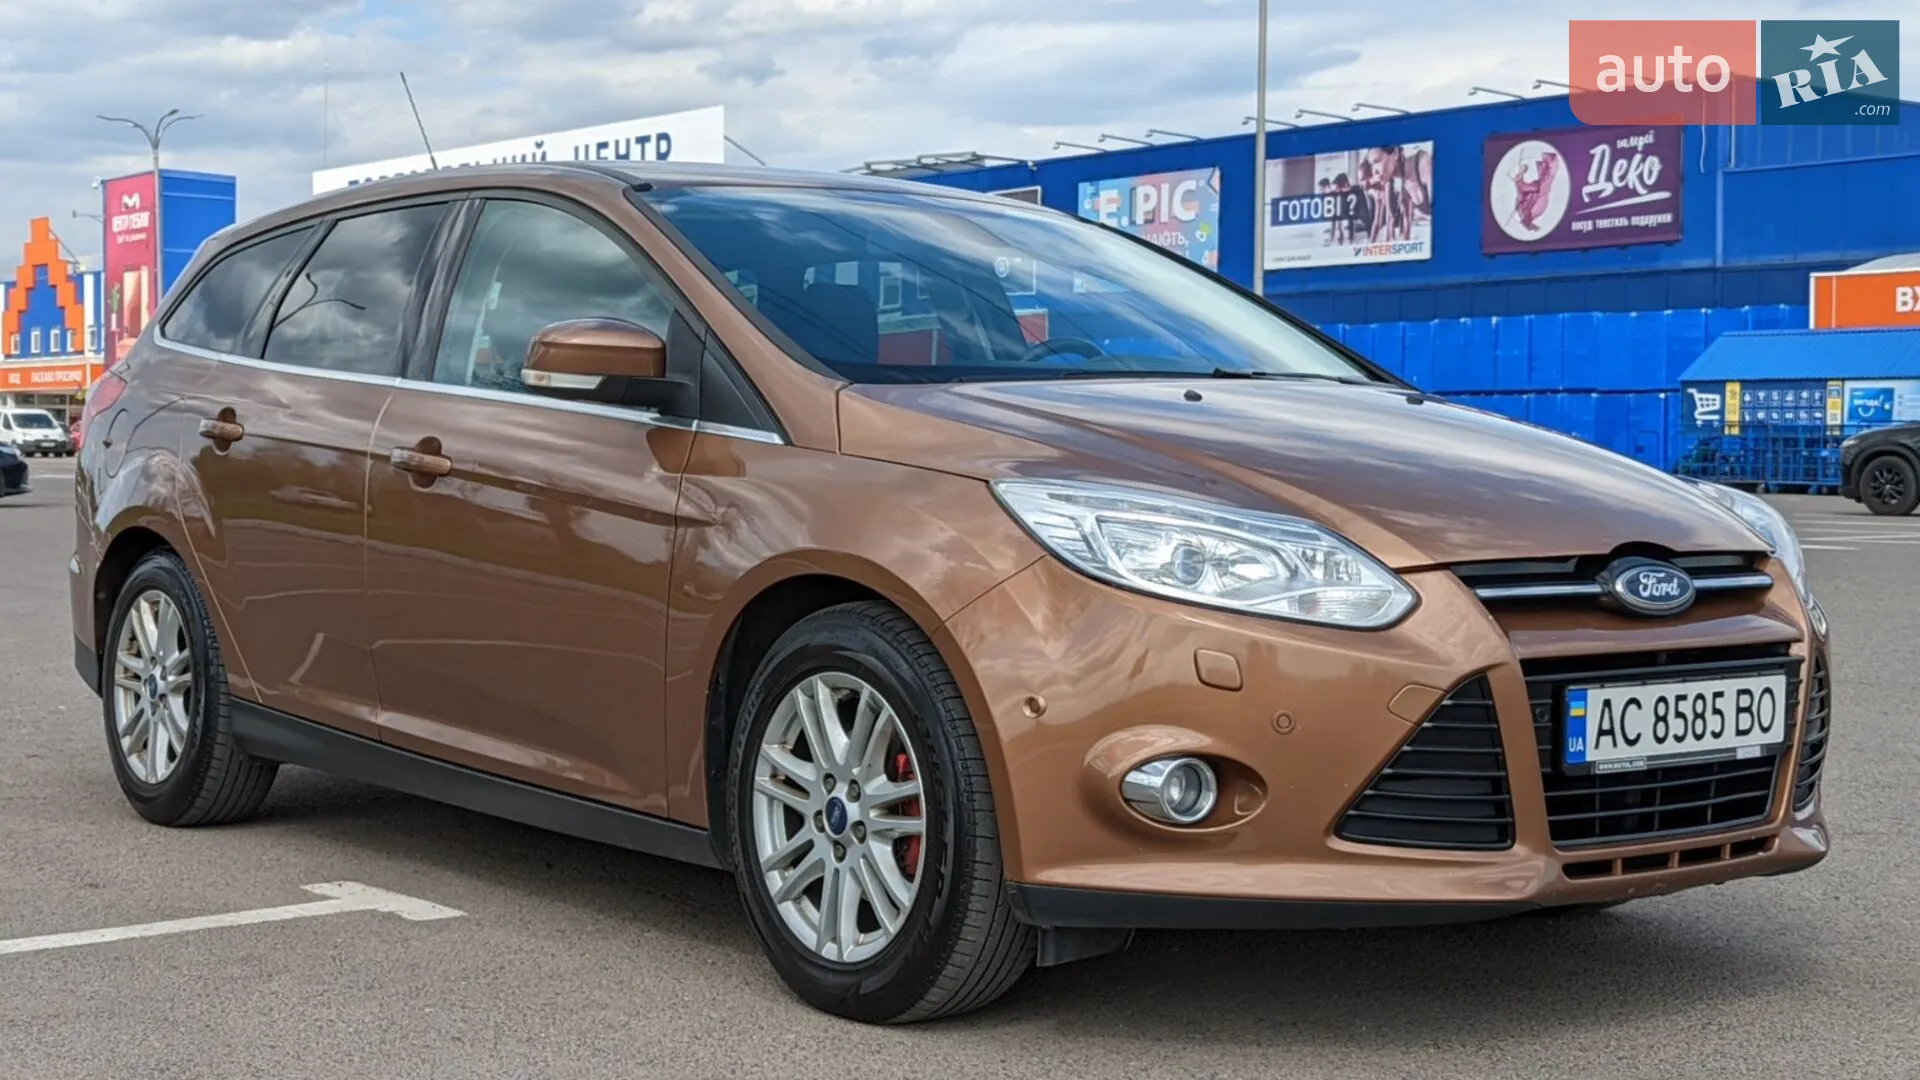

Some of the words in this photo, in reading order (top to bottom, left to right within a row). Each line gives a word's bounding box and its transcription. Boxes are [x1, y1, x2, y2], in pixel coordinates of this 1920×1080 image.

[1582, 143, 1662, 203] Деко
[1278, 195, 1341, 222] ГОТОВІ
[1362, 241, 1425, 257] INTERSPORT
[1639, 571, 1680, 598] Ford
[1594, 697, 1642, 750] AC
[1652, 690, 1725, 745] 8585
[1734, 686, 1776, 737] BO
[1568, 736, 1584, 752] UA
